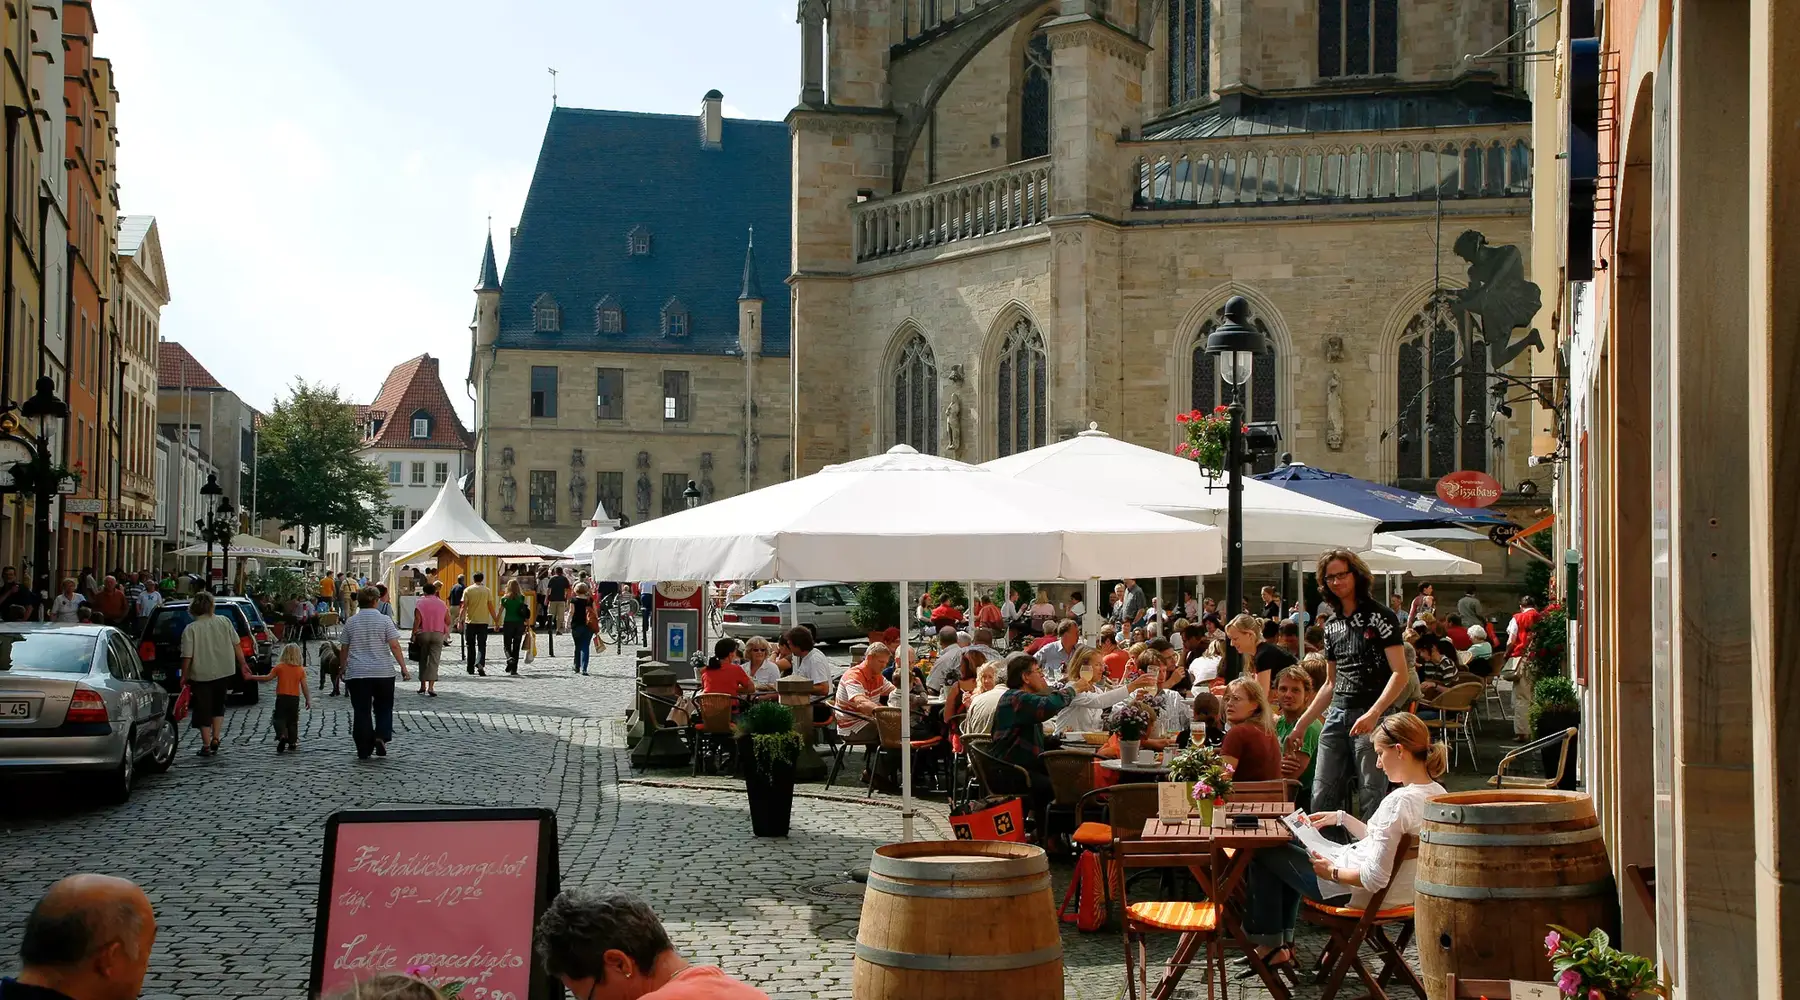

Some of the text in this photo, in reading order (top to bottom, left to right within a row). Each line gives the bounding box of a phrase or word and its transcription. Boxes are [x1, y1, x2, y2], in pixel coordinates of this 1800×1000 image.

[221, 546, 280, 554] AVERNA
[11, 703, 26, 715] 45
[333, 934, 524, 970] Latte macchiato
